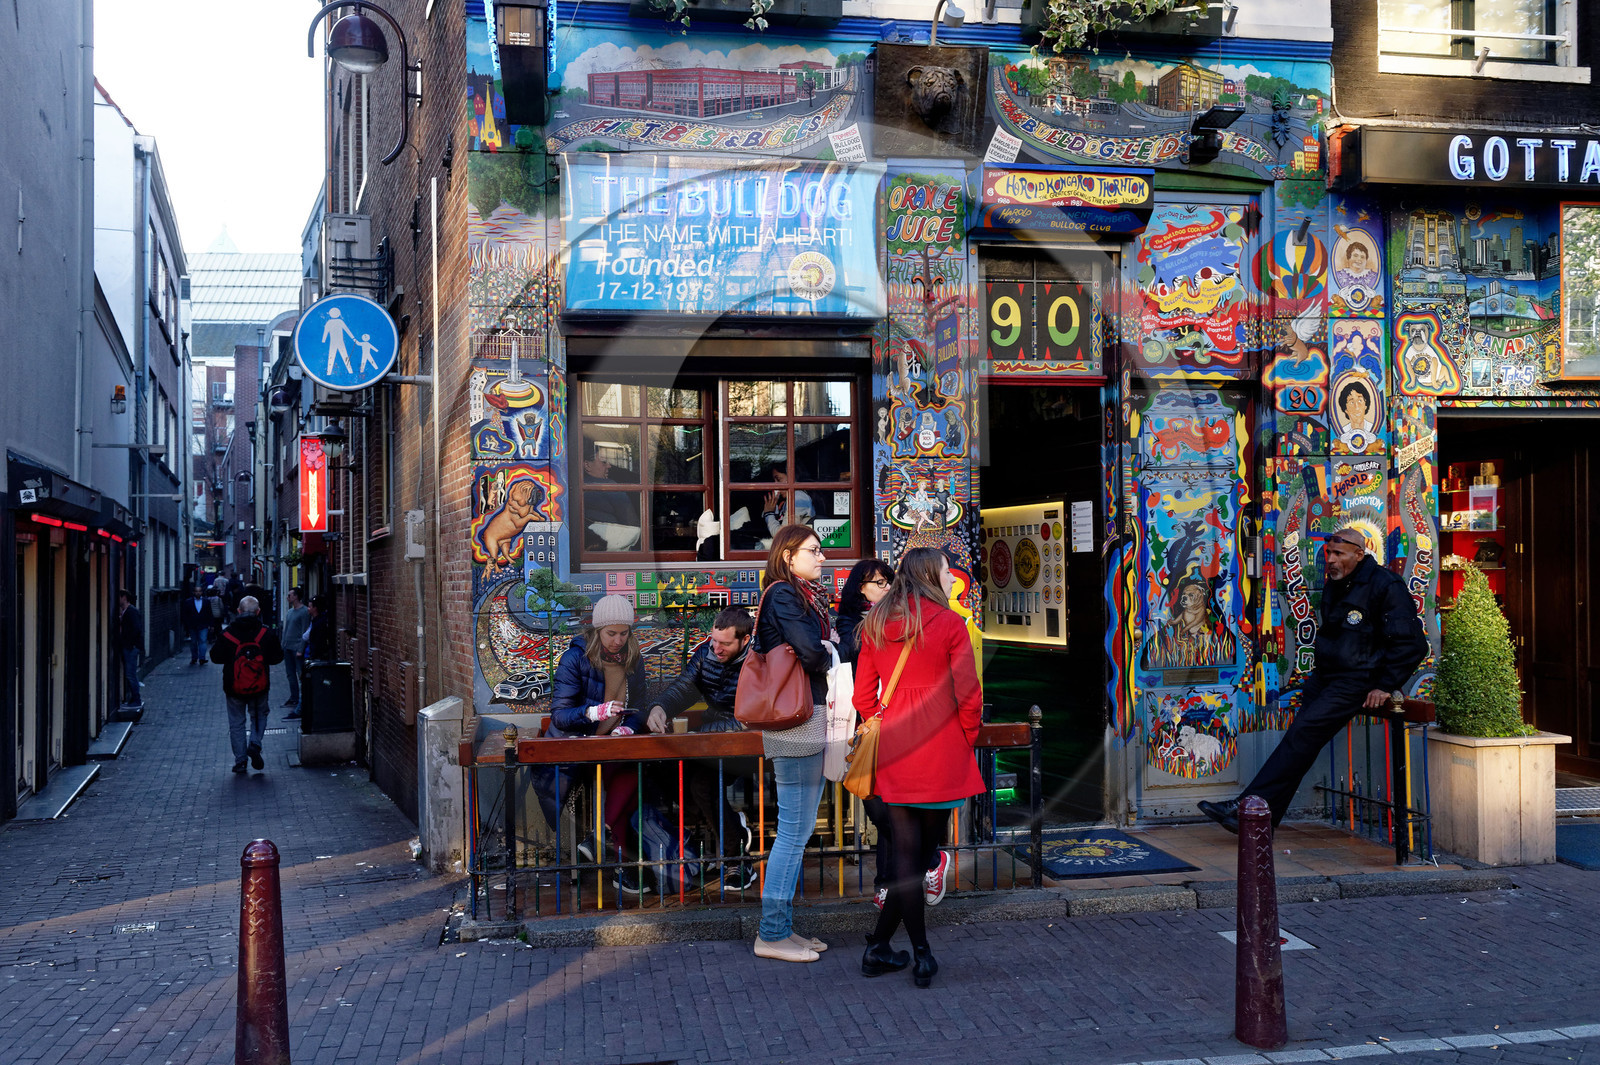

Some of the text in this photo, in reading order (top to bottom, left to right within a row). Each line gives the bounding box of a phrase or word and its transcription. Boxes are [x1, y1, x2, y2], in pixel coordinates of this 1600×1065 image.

[590, 107, 833, 148] FIRST BEST & BIGGEST
[1020, 118, 1116, 159] BULLDOG
[593, 176, 853, 221] THE BULLDOG
[889, 183, 962, 212] ORANGE
[999, 207, 1032, 220] HAROLD
[1035, 210, 1132, 223] PERMANENT MEMBER
[600, 223, 853, 247] THE NAME WITH A HEART!
[887, 215, 956, 243] JUICE
[1050, 221, 1086, 231] BULLDOG
[1089, 224, 1112, 232] CLUB
[1163, 228, 1187, 241] BULLDOG
[596, 252, 724, 277] Founded:
[597, 282, 715, 301] 17-12-1975
[791, 281, 833, 299] AMSTERDAM
[943, 326, 951, 340] THE
[1474, 331, 1537, 357] CANADA
[937, 340, 958, 363] BULLDOG
[1289, 386, 1319, 409] 90
[1283, 530, 1317, 673] BULLDOG
[1408, 533, 1432, 660] BULLD
